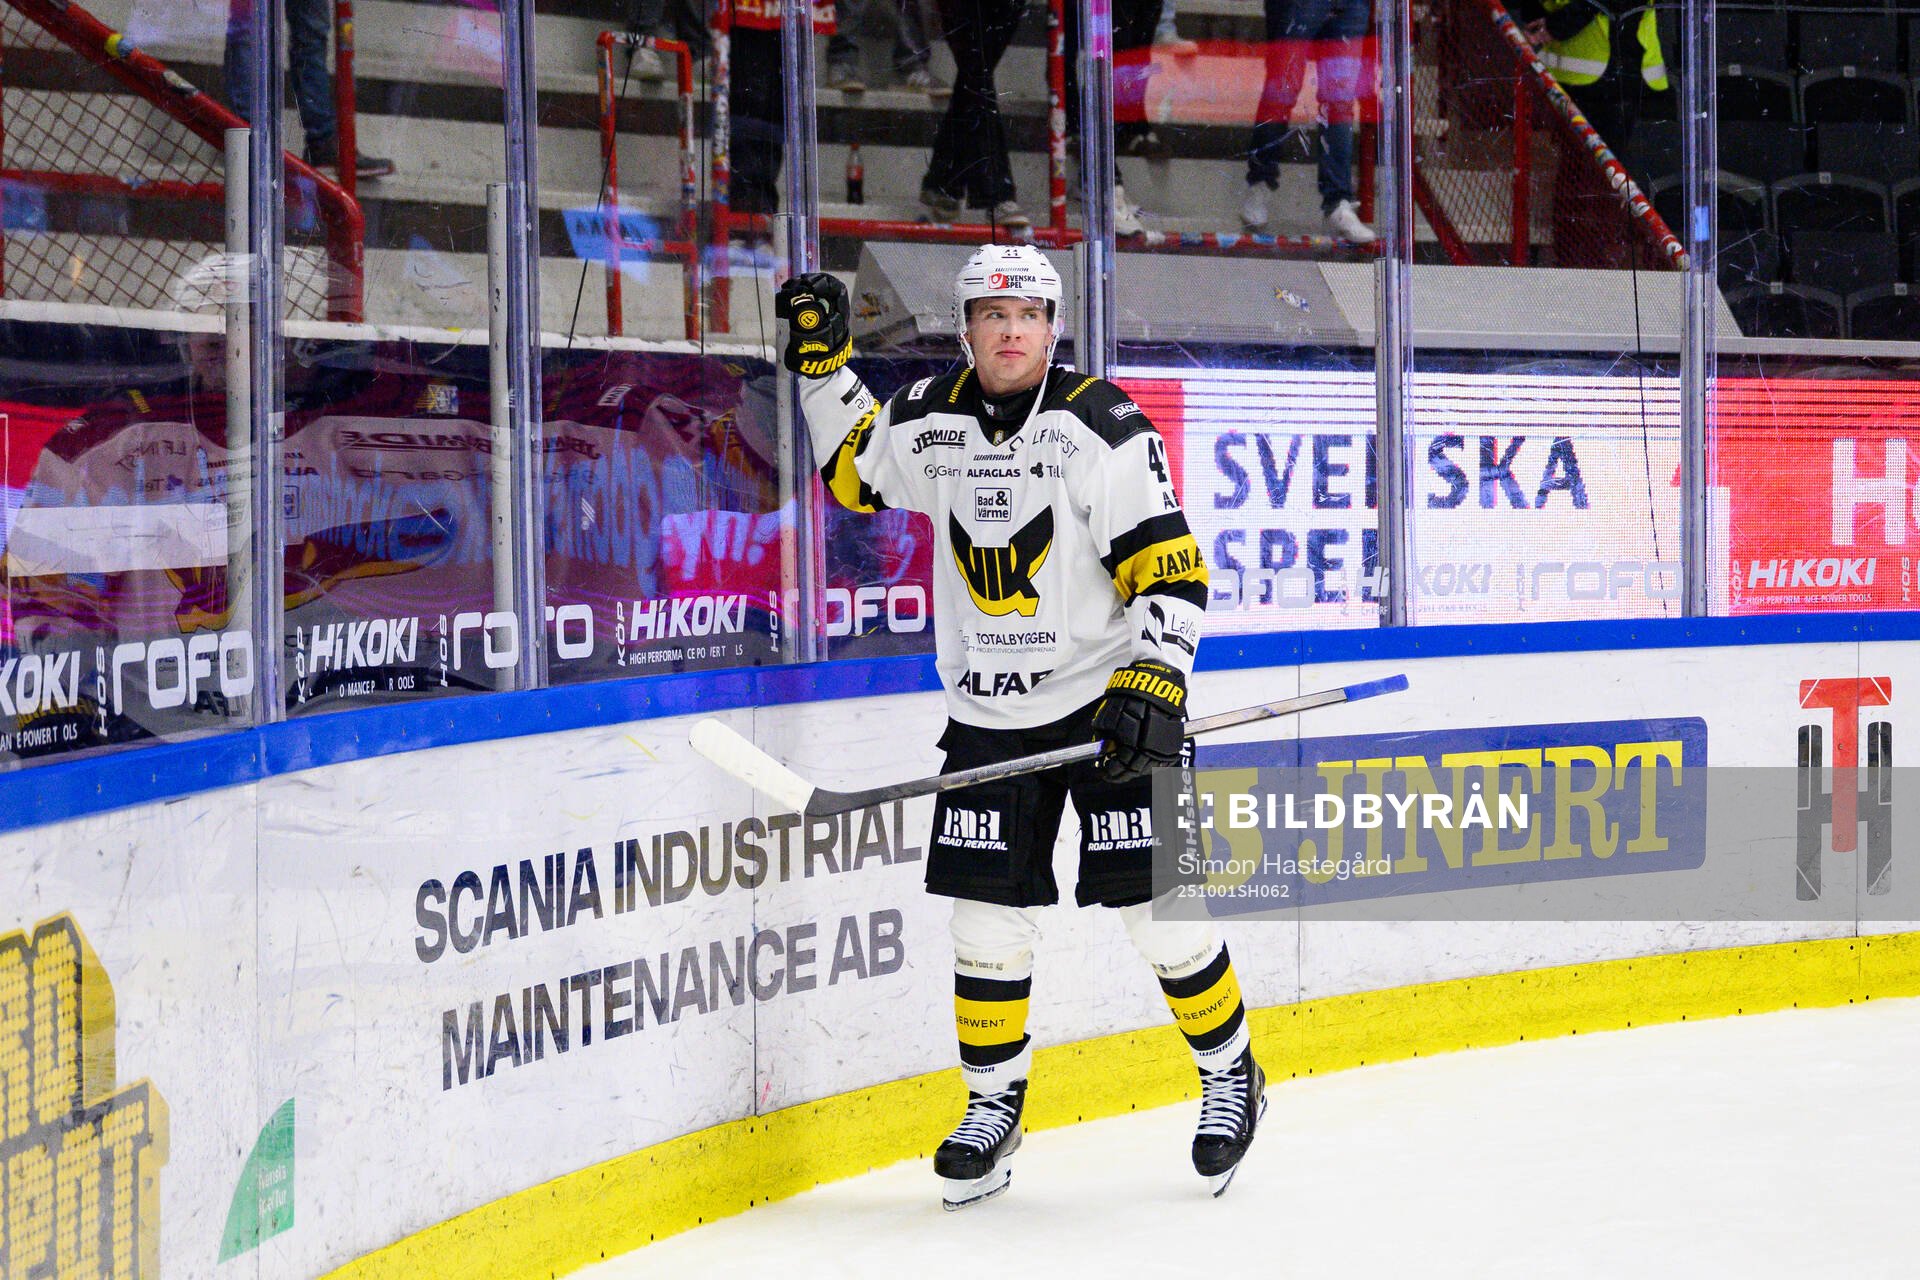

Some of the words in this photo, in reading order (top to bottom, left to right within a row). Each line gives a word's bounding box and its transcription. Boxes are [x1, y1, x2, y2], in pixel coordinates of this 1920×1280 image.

[1006, 274, 1036, 282] SVENSKA
[967, 468, 1021, 478] ALFAGLAS
[977, 496, 994, 506] Bad
[995, 490, 1009, 506] &
[1832, 438, 1920, 546] H
[977, 507, 1009, 519] Värme
[1152, 549, 1192, 579] JAN
[1849, 593, 1872, 603] TOOLS
[976, 631, 1057, 646] TOTALBYGGEN
[629, 652, 647, 665] HIGH
[648, 648, 696, 664] PERFORMACE
[1107, 670, 1184, 707] ARRIOR
[23, 729, 52, 748] POWER
[52, 722, 79, 746] TOLS
[1300, 740, 1684, 884] JINERT
[937, 835, 963, 848] ROAD
[963, 839, 1009, 851] RENTAL
[1087, 841, 1114, 852] ROAD
[1115, 837, 1163, 850] RENTAL
[415, 846, 604, 964] SCANIA
[613, 799, 923, 916] INDUSTRIAL
[442, 922, 817, 1092] MAINTENANCE
[828, 907, 905, 986] AB
[1183, 986, 1232, 1021] SERWENT
